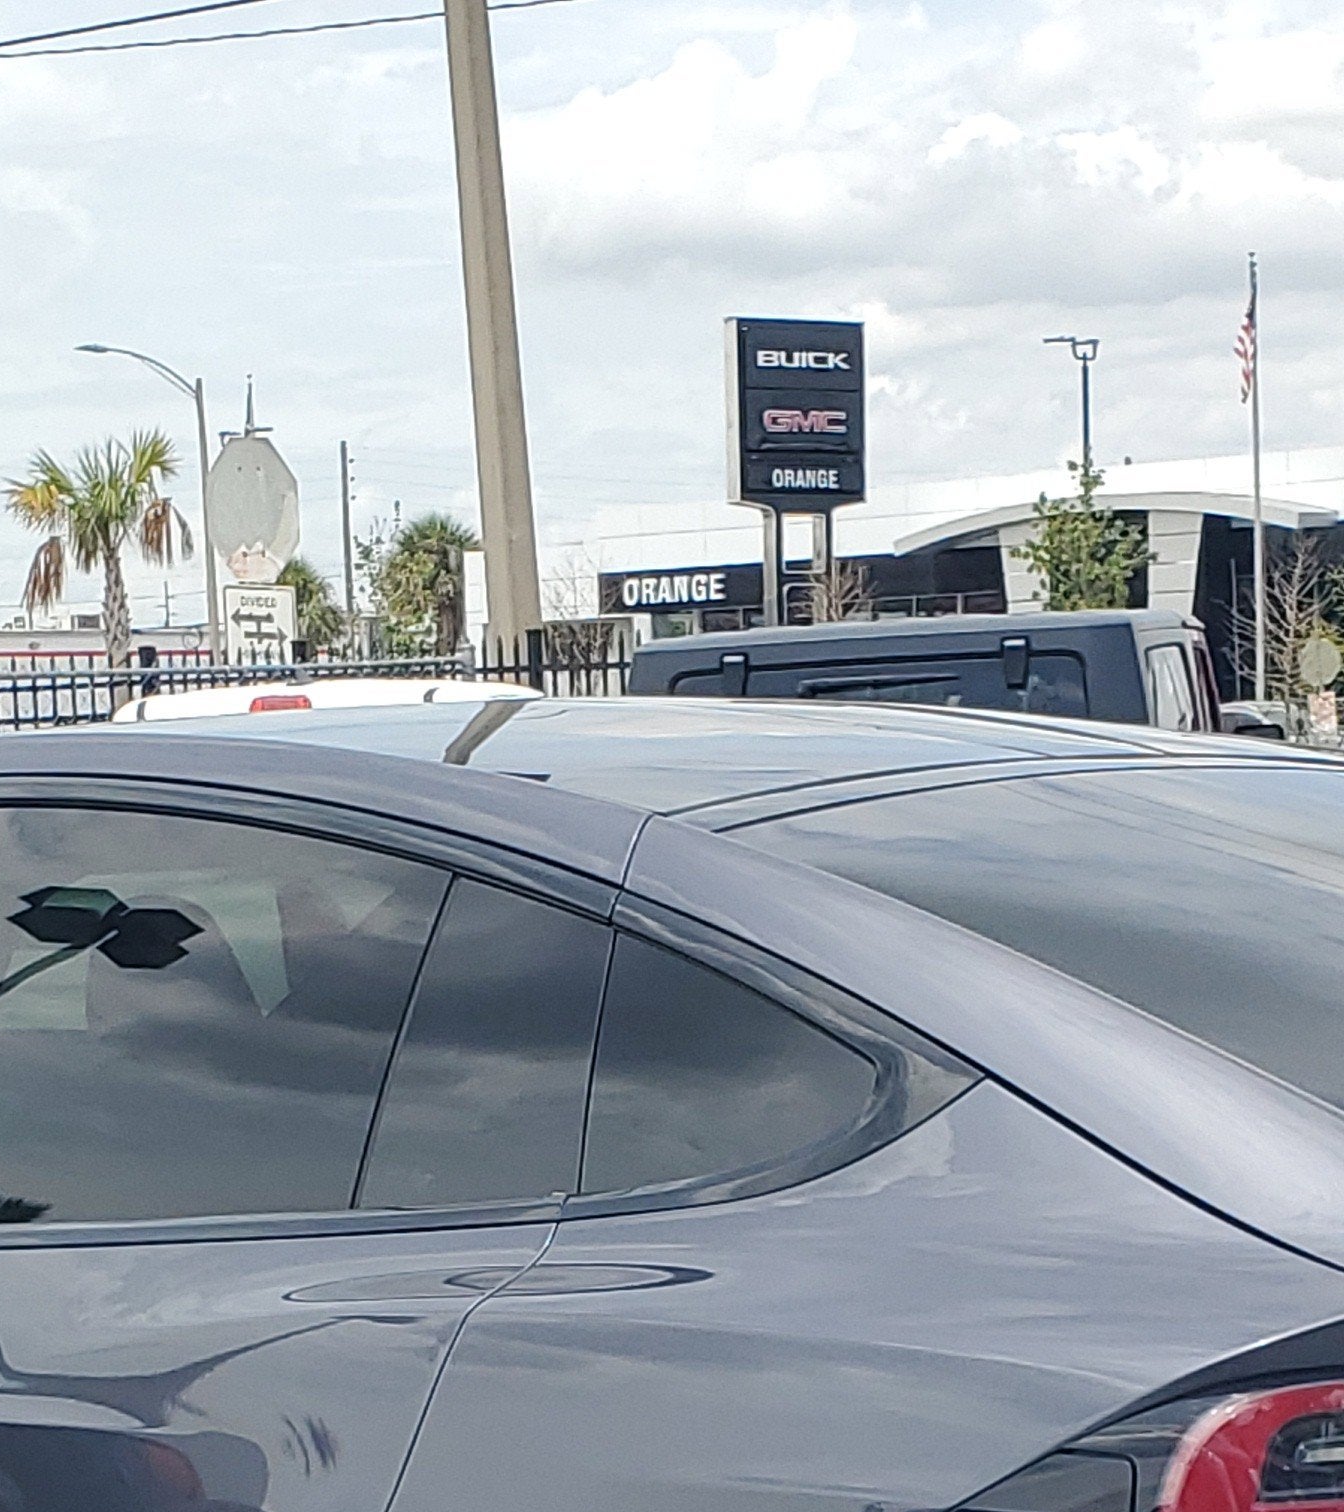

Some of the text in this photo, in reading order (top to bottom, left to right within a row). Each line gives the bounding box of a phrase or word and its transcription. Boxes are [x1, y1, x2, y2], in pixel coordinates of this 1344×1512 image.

[756, 350, 851, 370] BUICK
[762, 409, 848, 433] GMC
[771, 468, 840, 490] ORANGE
[621, 573, 727, 607] ORANGE
[240, 595, 278, 609] DIVIDED
